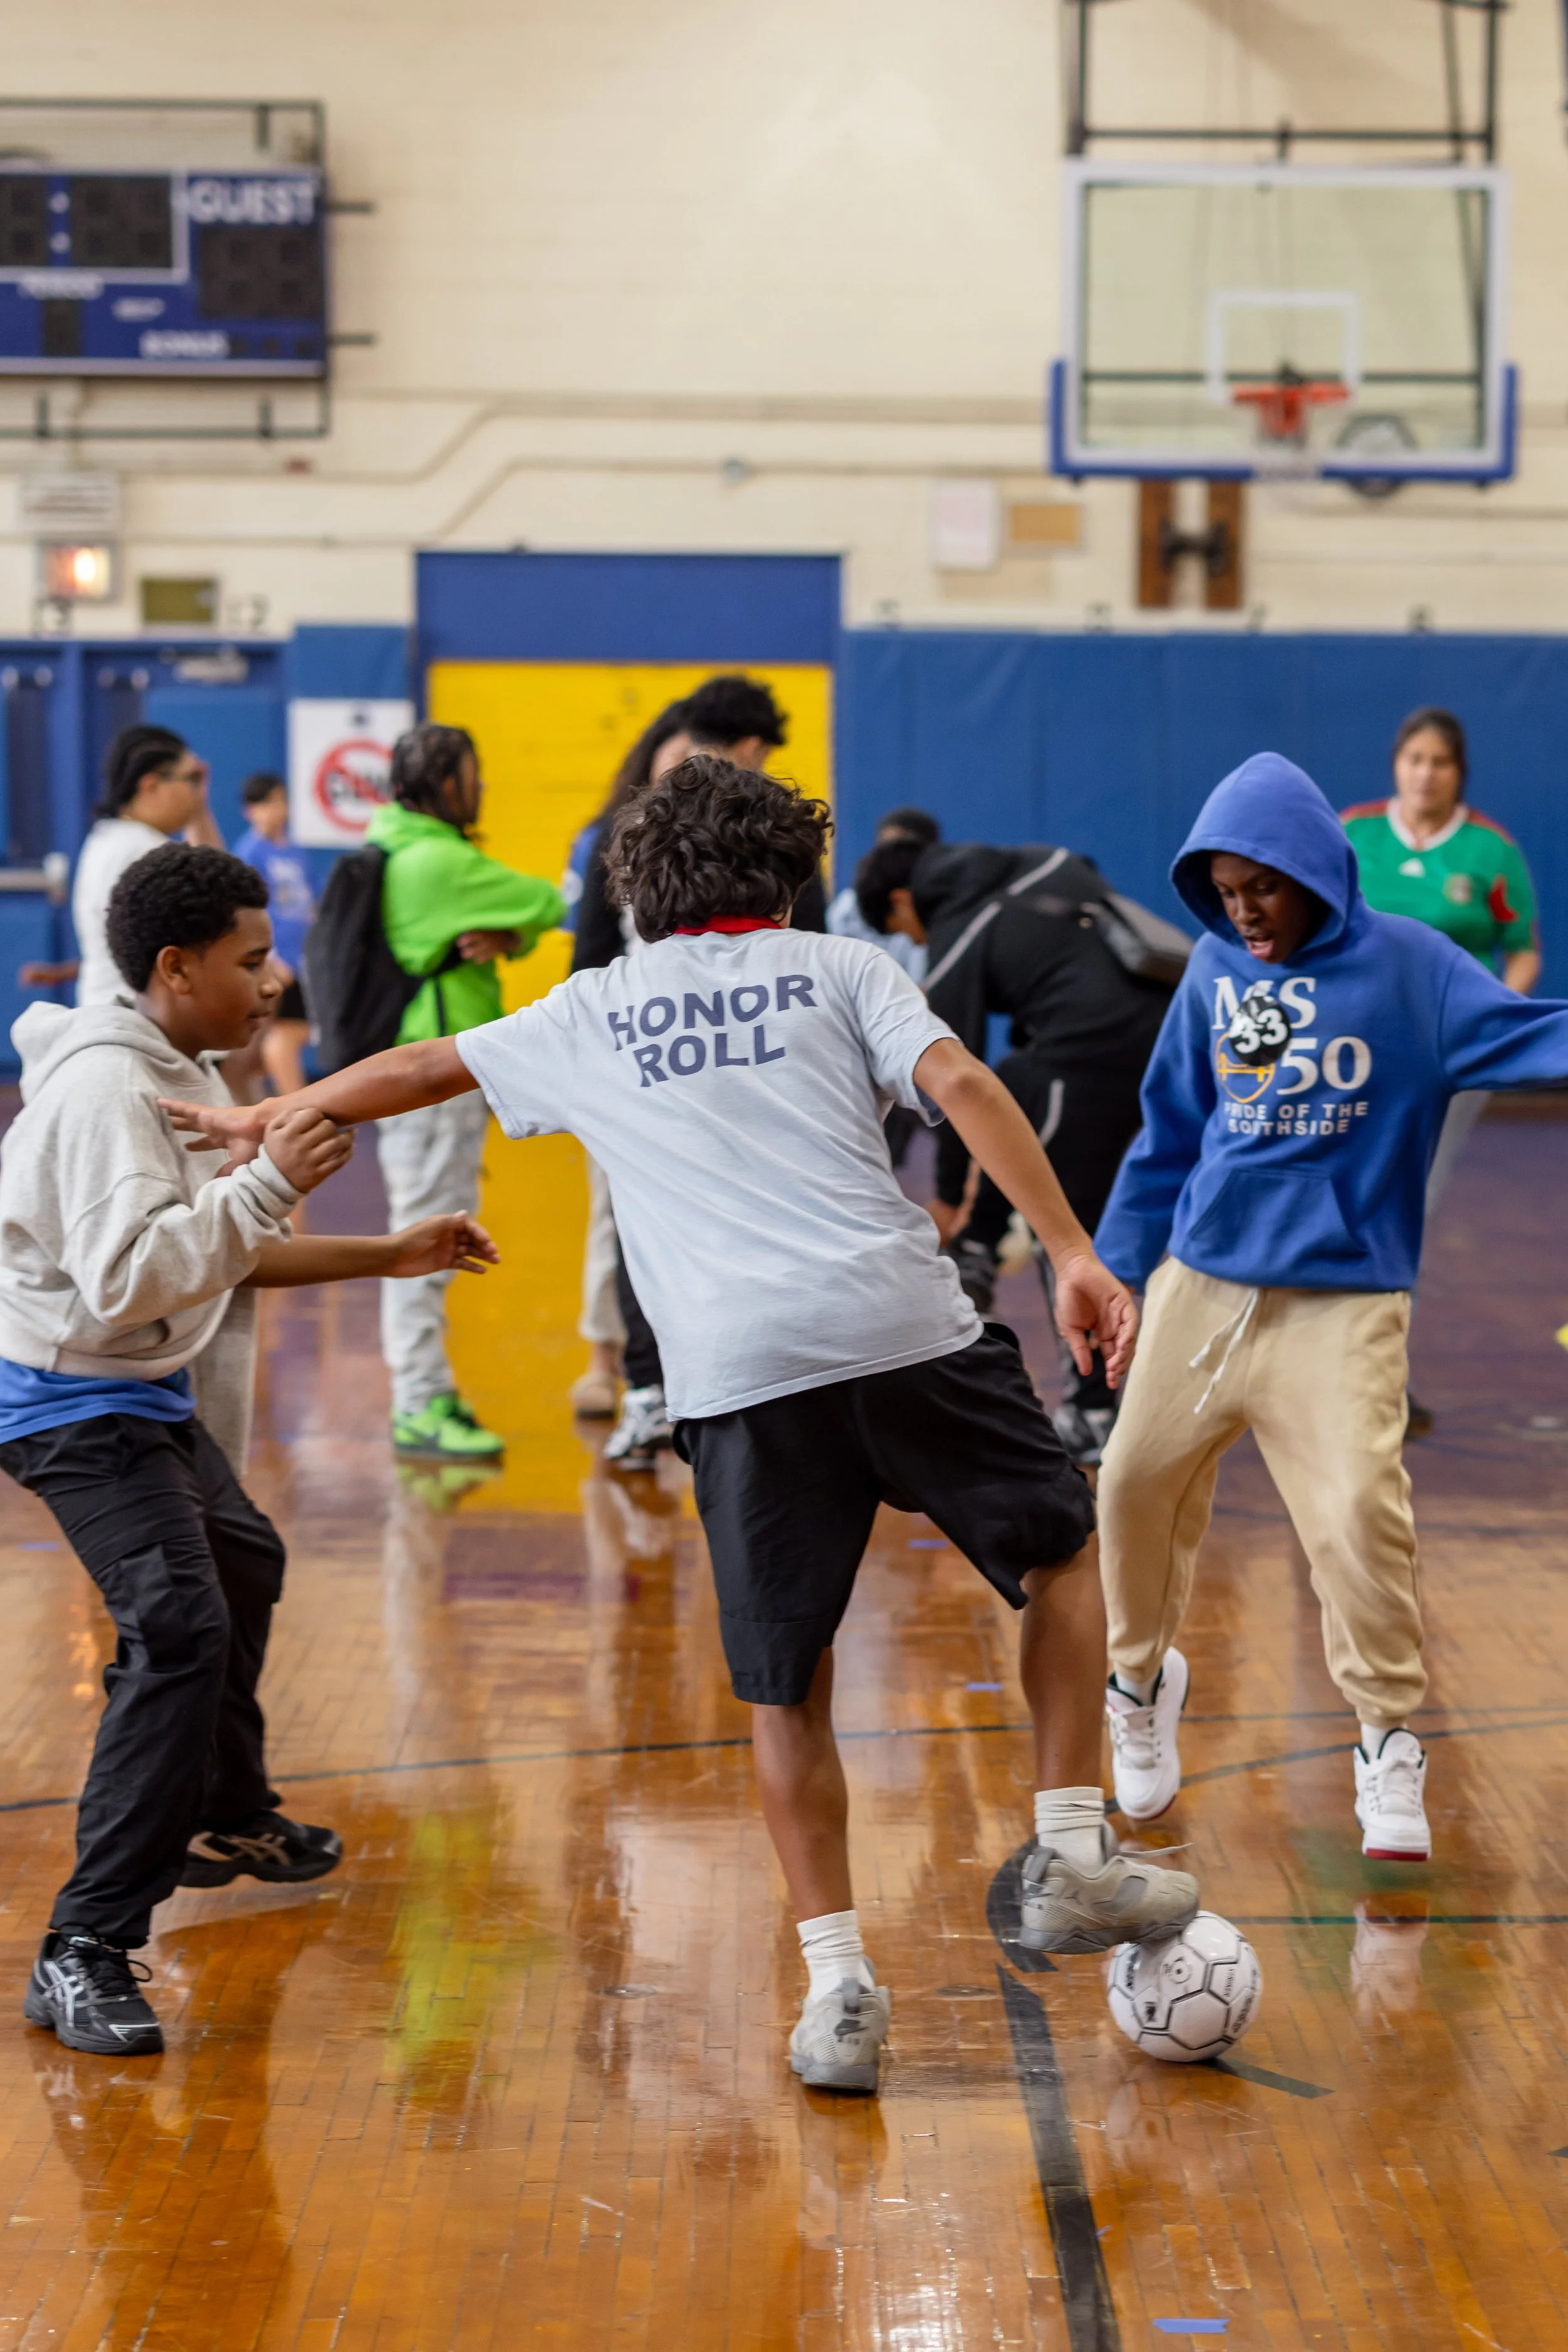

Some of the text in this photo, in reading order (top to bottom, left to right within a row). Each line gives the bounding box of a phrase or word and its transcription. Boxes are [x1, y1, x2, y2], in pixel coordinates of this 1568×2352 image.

[608, 975, 817, 1051] HONOR
[633, 1025, 785, 1088] ROLL
[1276, 1036, 1371, 1095] 50
[1278, 1104, 1311, 1120] OF
[1322, 1101, 1369, 1118] THE
